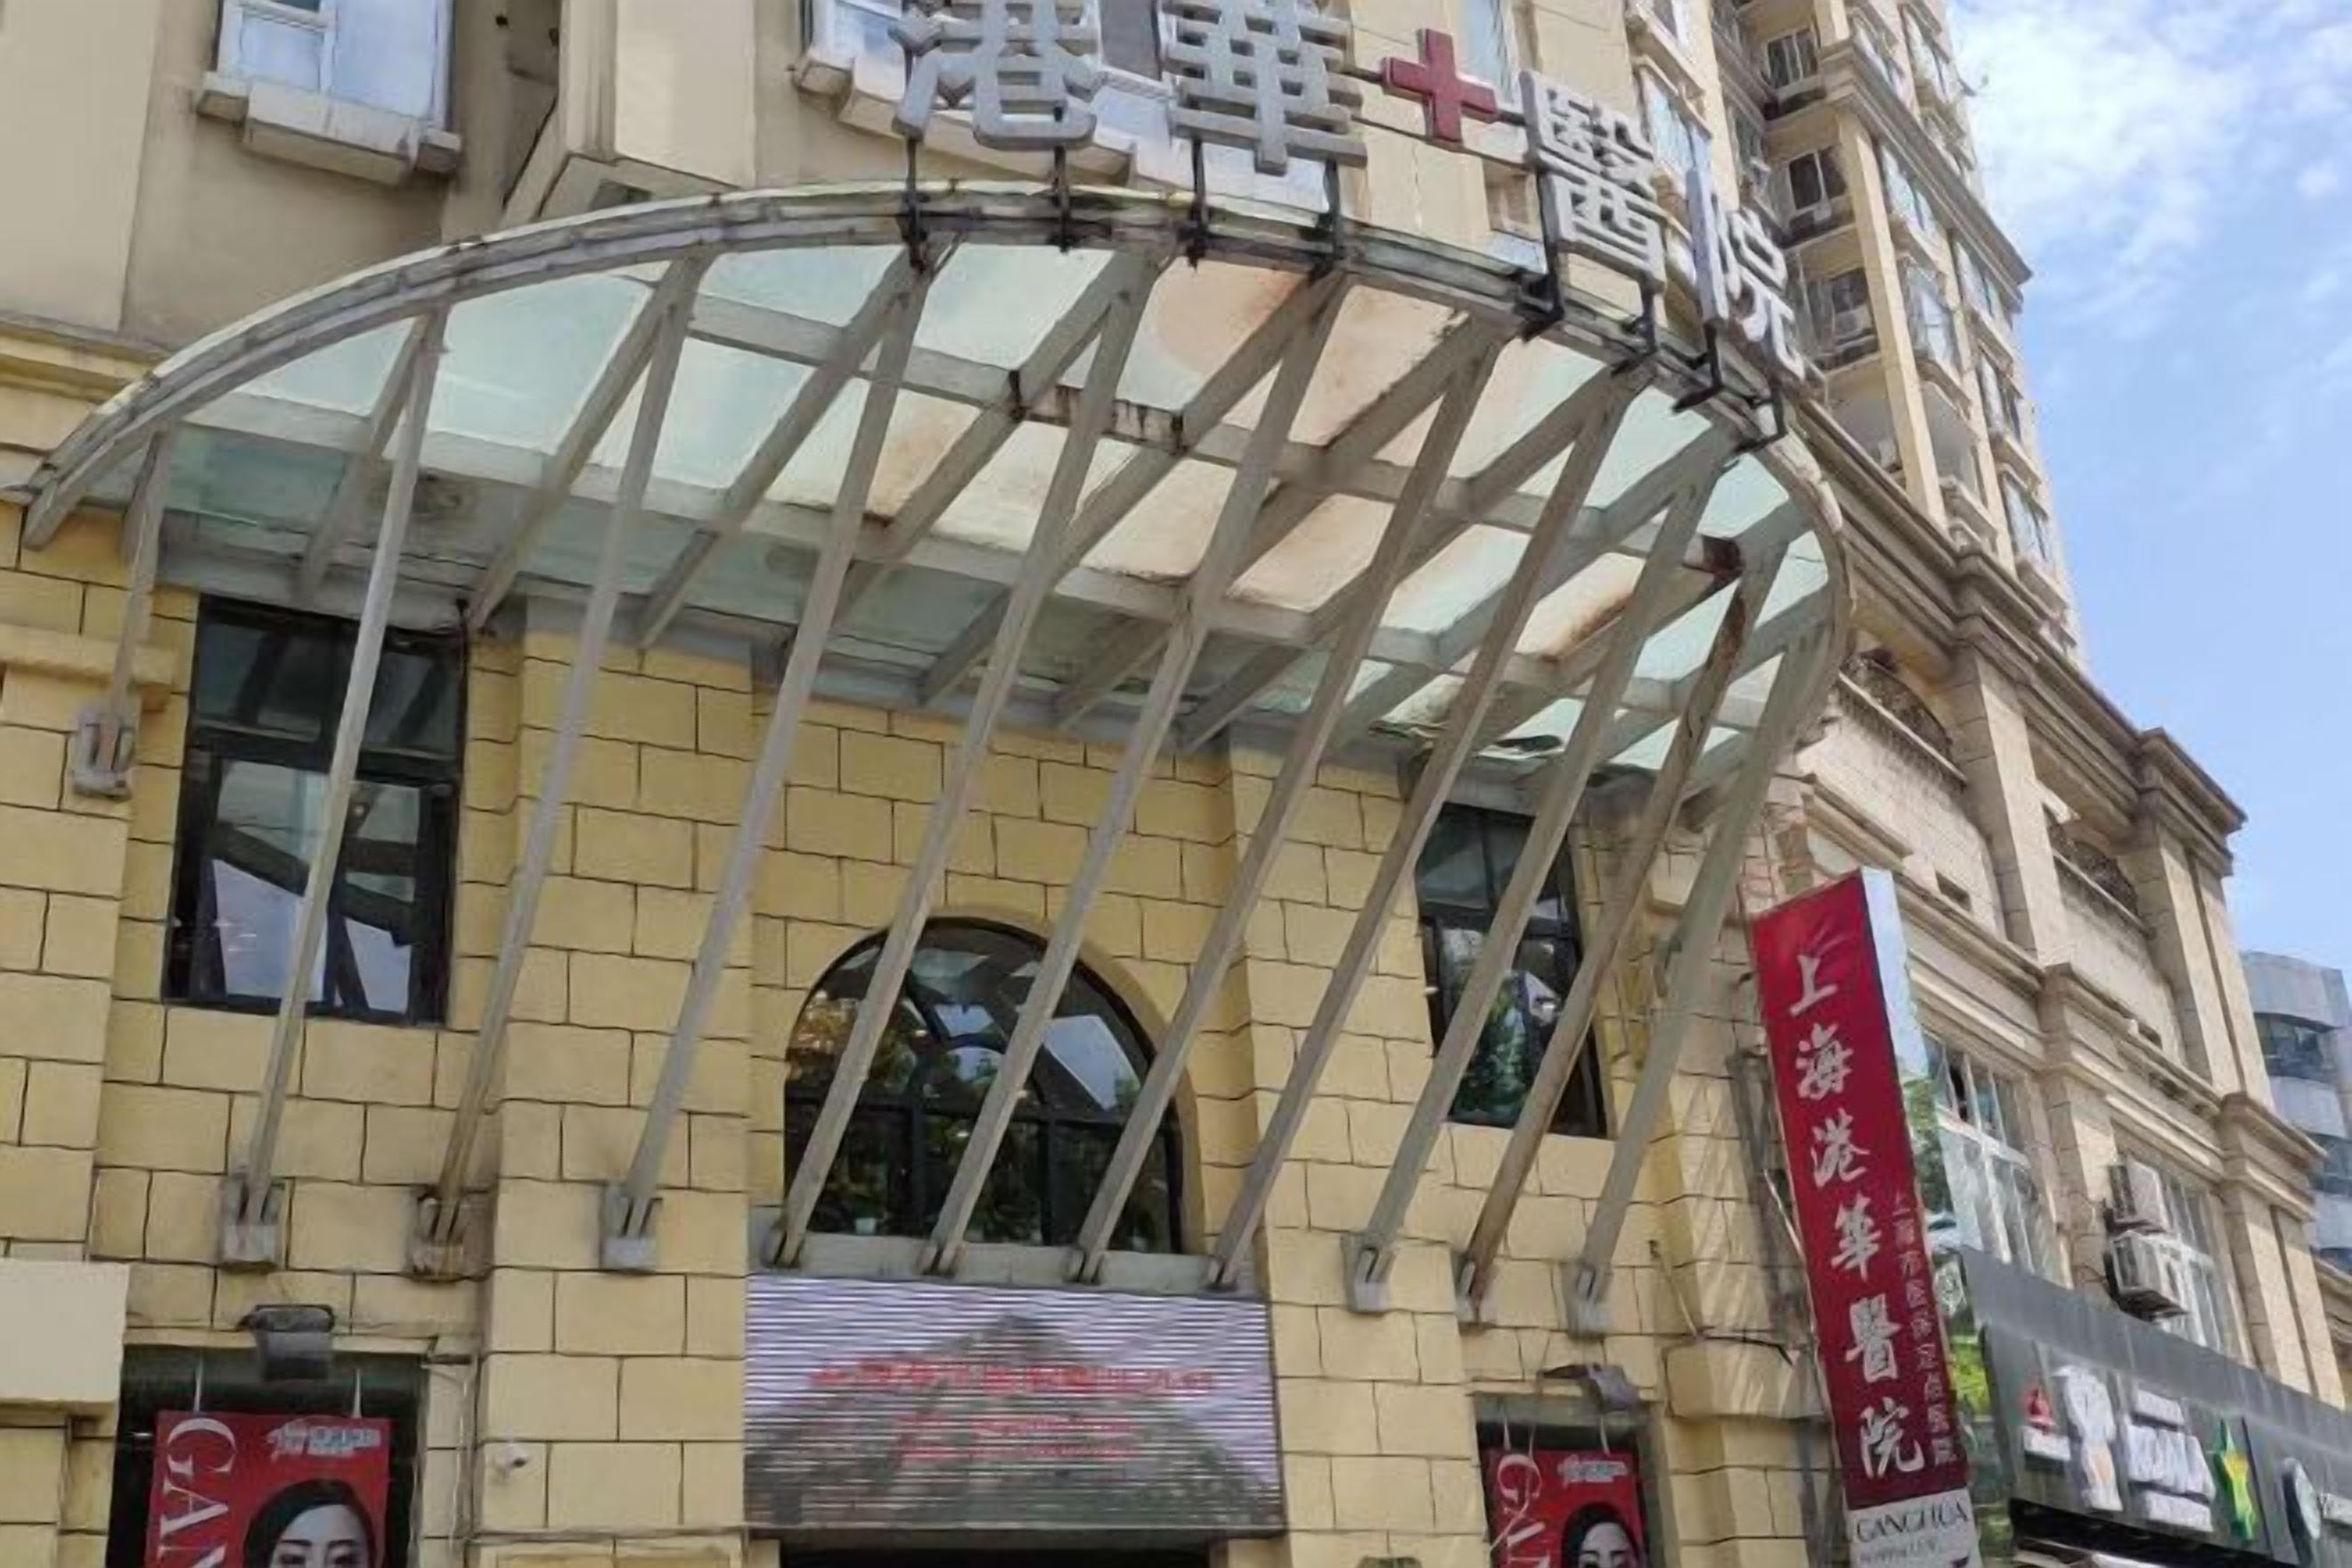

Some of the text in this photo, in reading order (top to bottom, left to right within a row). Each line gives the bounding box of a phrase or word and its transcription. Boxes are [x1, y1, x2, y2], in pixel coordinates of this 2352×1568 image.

[1518, 69, 1809, 381] 醫院
[1789, 954, 1925, 1478] 上海港華醫院
